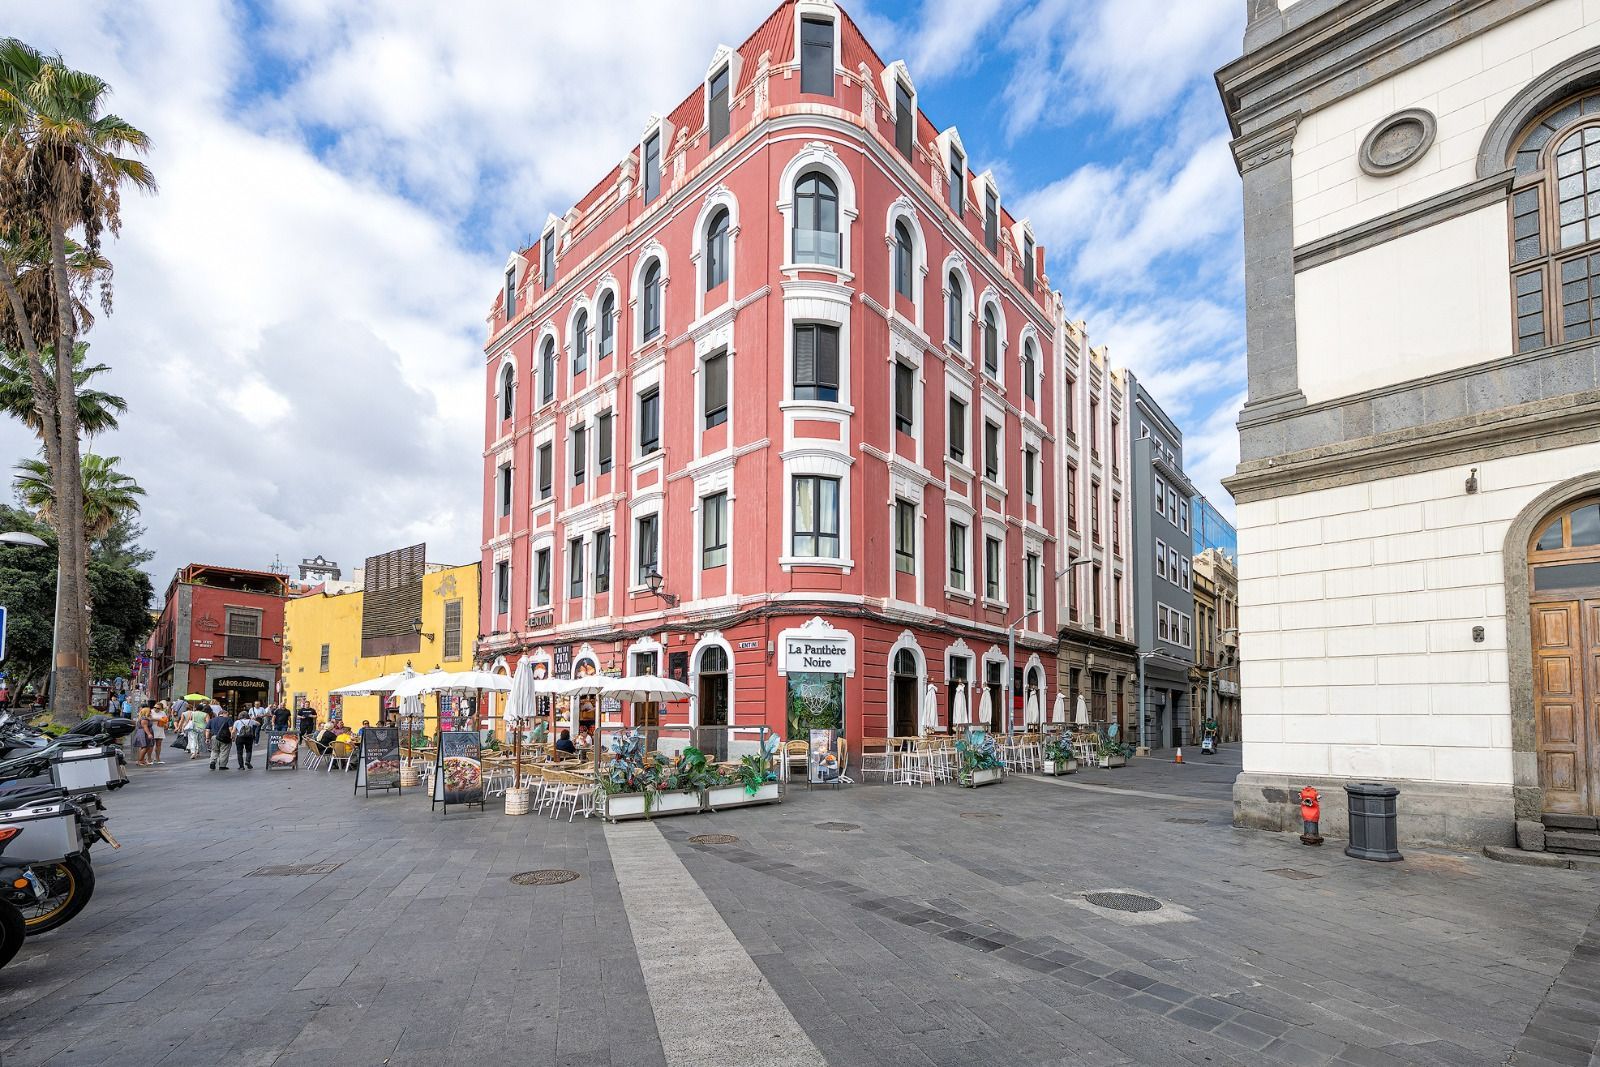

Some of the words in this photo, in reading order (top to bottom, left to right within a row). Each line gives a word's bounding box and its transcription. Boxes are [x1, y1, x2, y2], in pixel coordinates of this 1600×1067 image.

[788, 644, 802, 654] La
[804, 644, 846, 655] Panthère
[803, 657, 832, 667] Noire
[218, 679, 238, 687] SABOR
